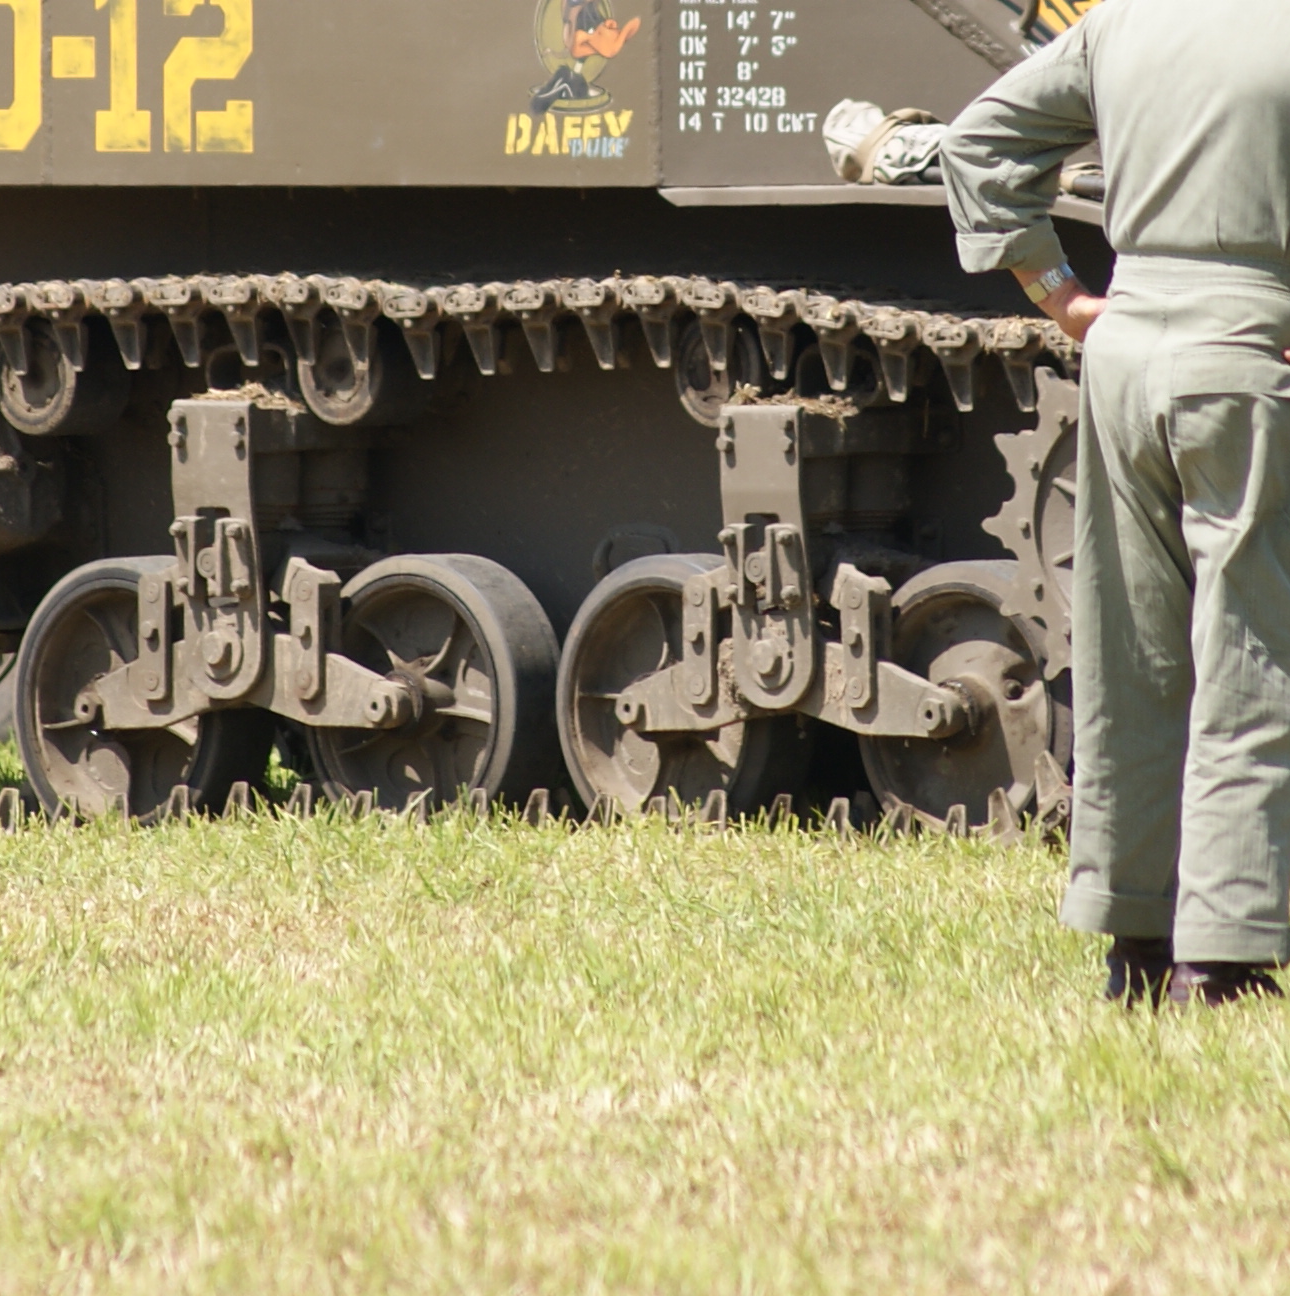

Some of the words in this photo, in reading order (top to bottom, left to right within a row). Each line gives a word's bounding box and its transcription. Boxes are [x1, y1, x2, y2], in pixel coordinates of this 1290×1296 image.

[679, 10, 708, 31] OL
[679, 35, 708, 56] OW
[679, 60, 707, 81] HT
[736, 60, 759, 82] 8'
[679, 86, 707, 106] NW
[717, 86, 786, 107] 32428
[505, 109, 633, 155] DAFFY
[679, 112, 702, 132] 14
[711, 112, 725, 132] T
[744, 112, 769, 132] 10
[776, 112, 819, 133] CWT
